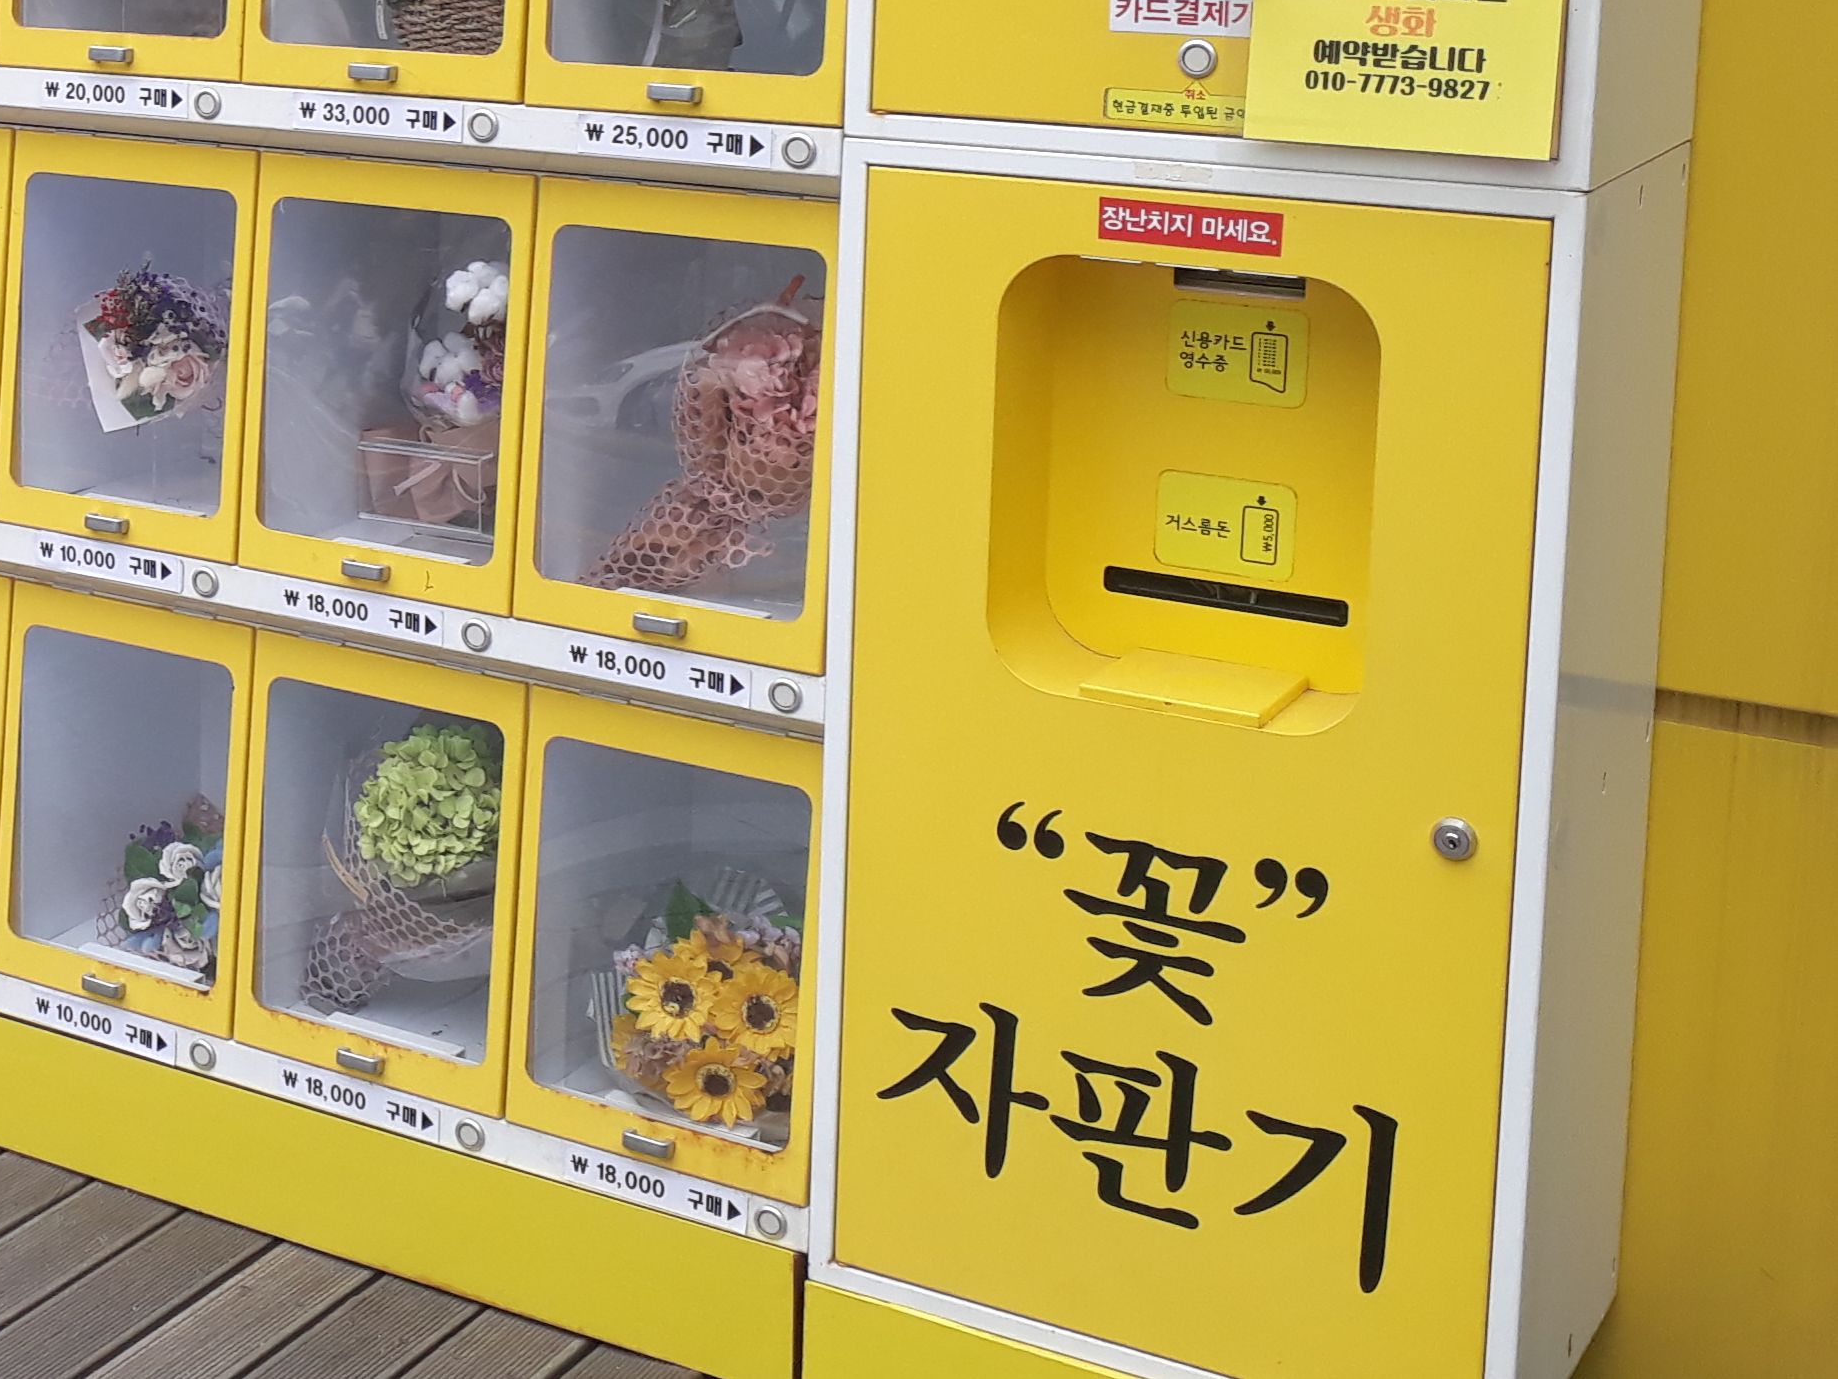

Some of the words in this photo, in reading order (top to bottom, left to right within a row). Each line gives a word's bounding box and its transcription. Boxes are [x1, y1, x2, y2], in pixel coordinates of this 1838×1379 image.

[1365, 5, 1436, 38] 생화
[1313, 39, 1486, 73] 예약받습니다
[45, 81, 61, 97] ₩
[65, 82, 125, 104] 20,000
[139, 87, 168, 108] 구매
[1184, 89, 1206, 101] 취소
[1305, 70, 1490, 100] 010-7773-9827
[298, 102, 317, 119] ₩
[322, 102, 391, 127] 33,000
[405, 109, 438, 132] 구매
[1180, 104, 1218, 120] 투입된
[584, 123, 605, 141] ₩
[611, 124, 689, 150] 25,000
[705, 132, 743, 157] 구매
[1102, 205, 1193, 239] 장난치지
[1201, 216, 1277, 246] 마세요.
[1181, 330, 1247, 352] 신용카드
[1179, 350, 1229, 372] 영수증
[1165, 514, 1230, 539] 거스름돈
[39, 541, 54, 558] ₩
[59, 544, 116, 570] 10,000
[129, 557, 157, 579] 구매
[283, 589, 300, 607] ₩
[306, 593, 369, 622] 18,000
[389, 608, 420, 635] 구매
[568, 645, 588, 663] ₩
[595, 650, 666, 680] 18,000
[689, 667, 725, 694] 구매
[36, 996, 51, 1015] ₩
[56, 1003, 112, 1035] 10,000
[125, 1024, 153, 1048] 구매
[282, 1069, 300, 1087] ₩
[305, 1076, 367, 1111] 18,000
[385, 1100, 417, 1129] 구매
[877, 1002, 1397, 1294] 자판기
[570, 1153, 590, 1174] ₩
[596, 1162, 666, 1199] 18,000
[686, 1188, 722, 1216] 구매
